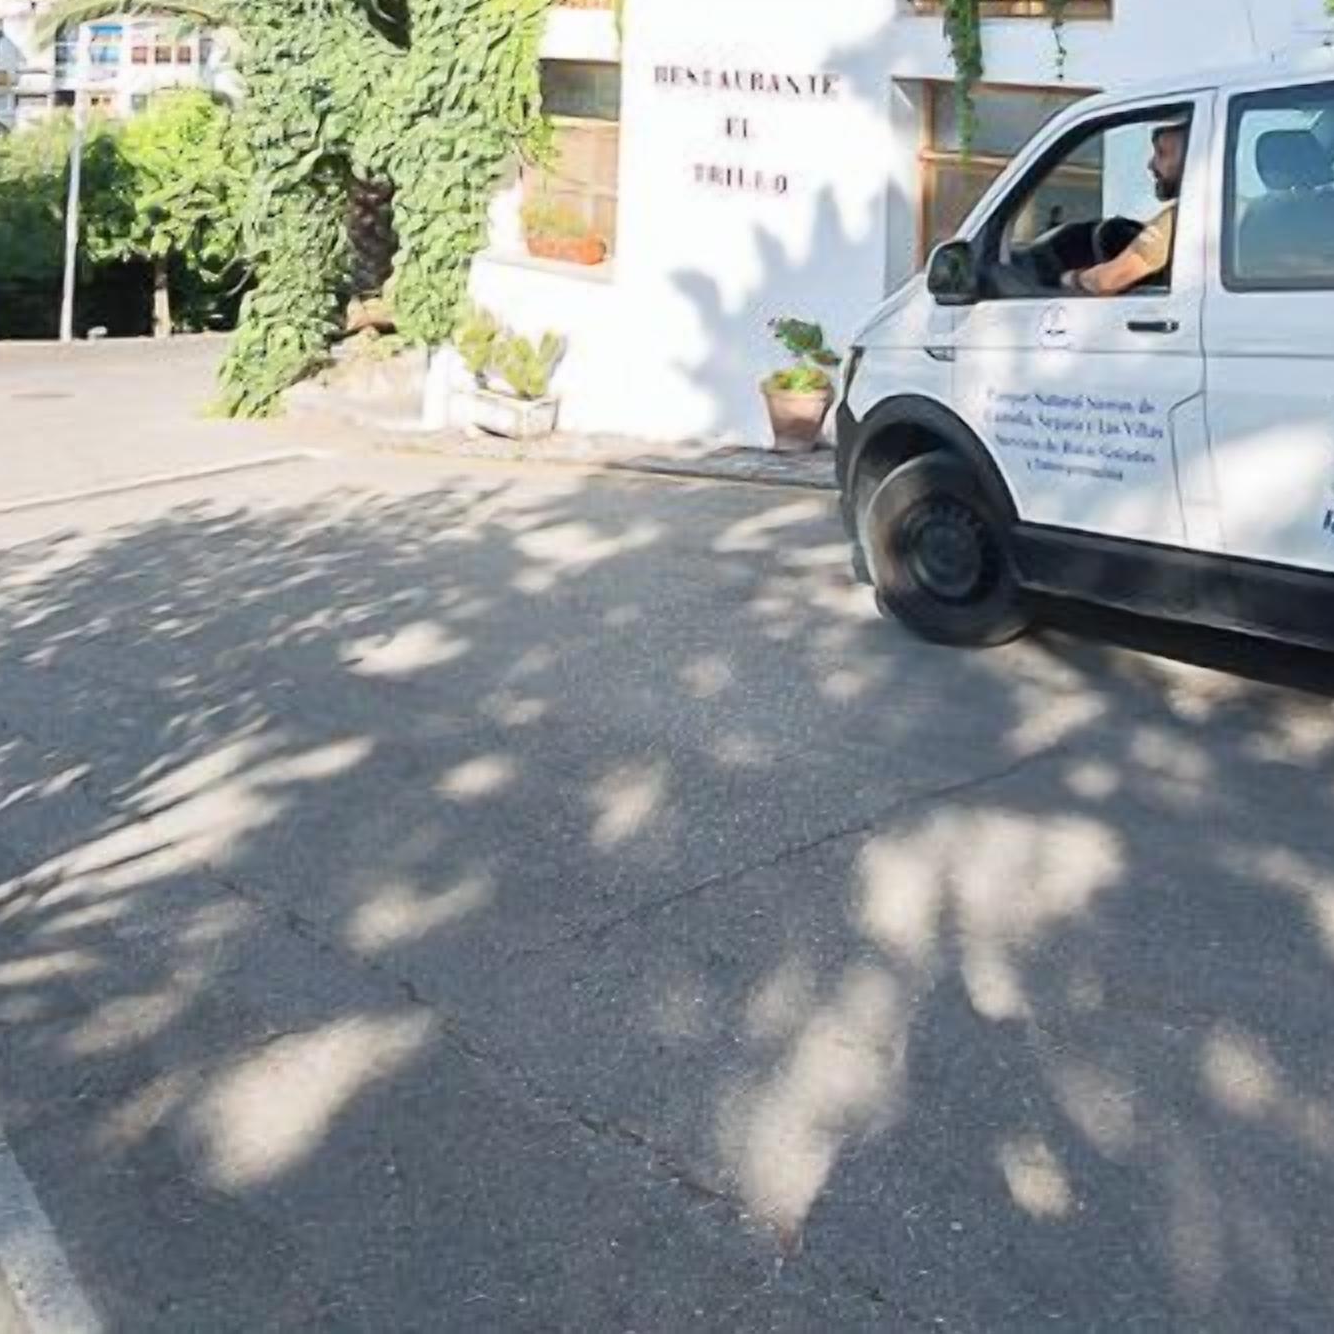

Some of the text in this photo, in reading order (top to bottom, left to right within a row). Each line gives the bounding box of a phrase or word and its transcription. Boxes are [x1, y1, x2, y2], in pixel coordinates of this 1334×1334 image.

[653, 64, 840, 100] RESTAURANTE
[725, 116, 754, 139] EL
[693, 163, 788, 195] TRILLO
